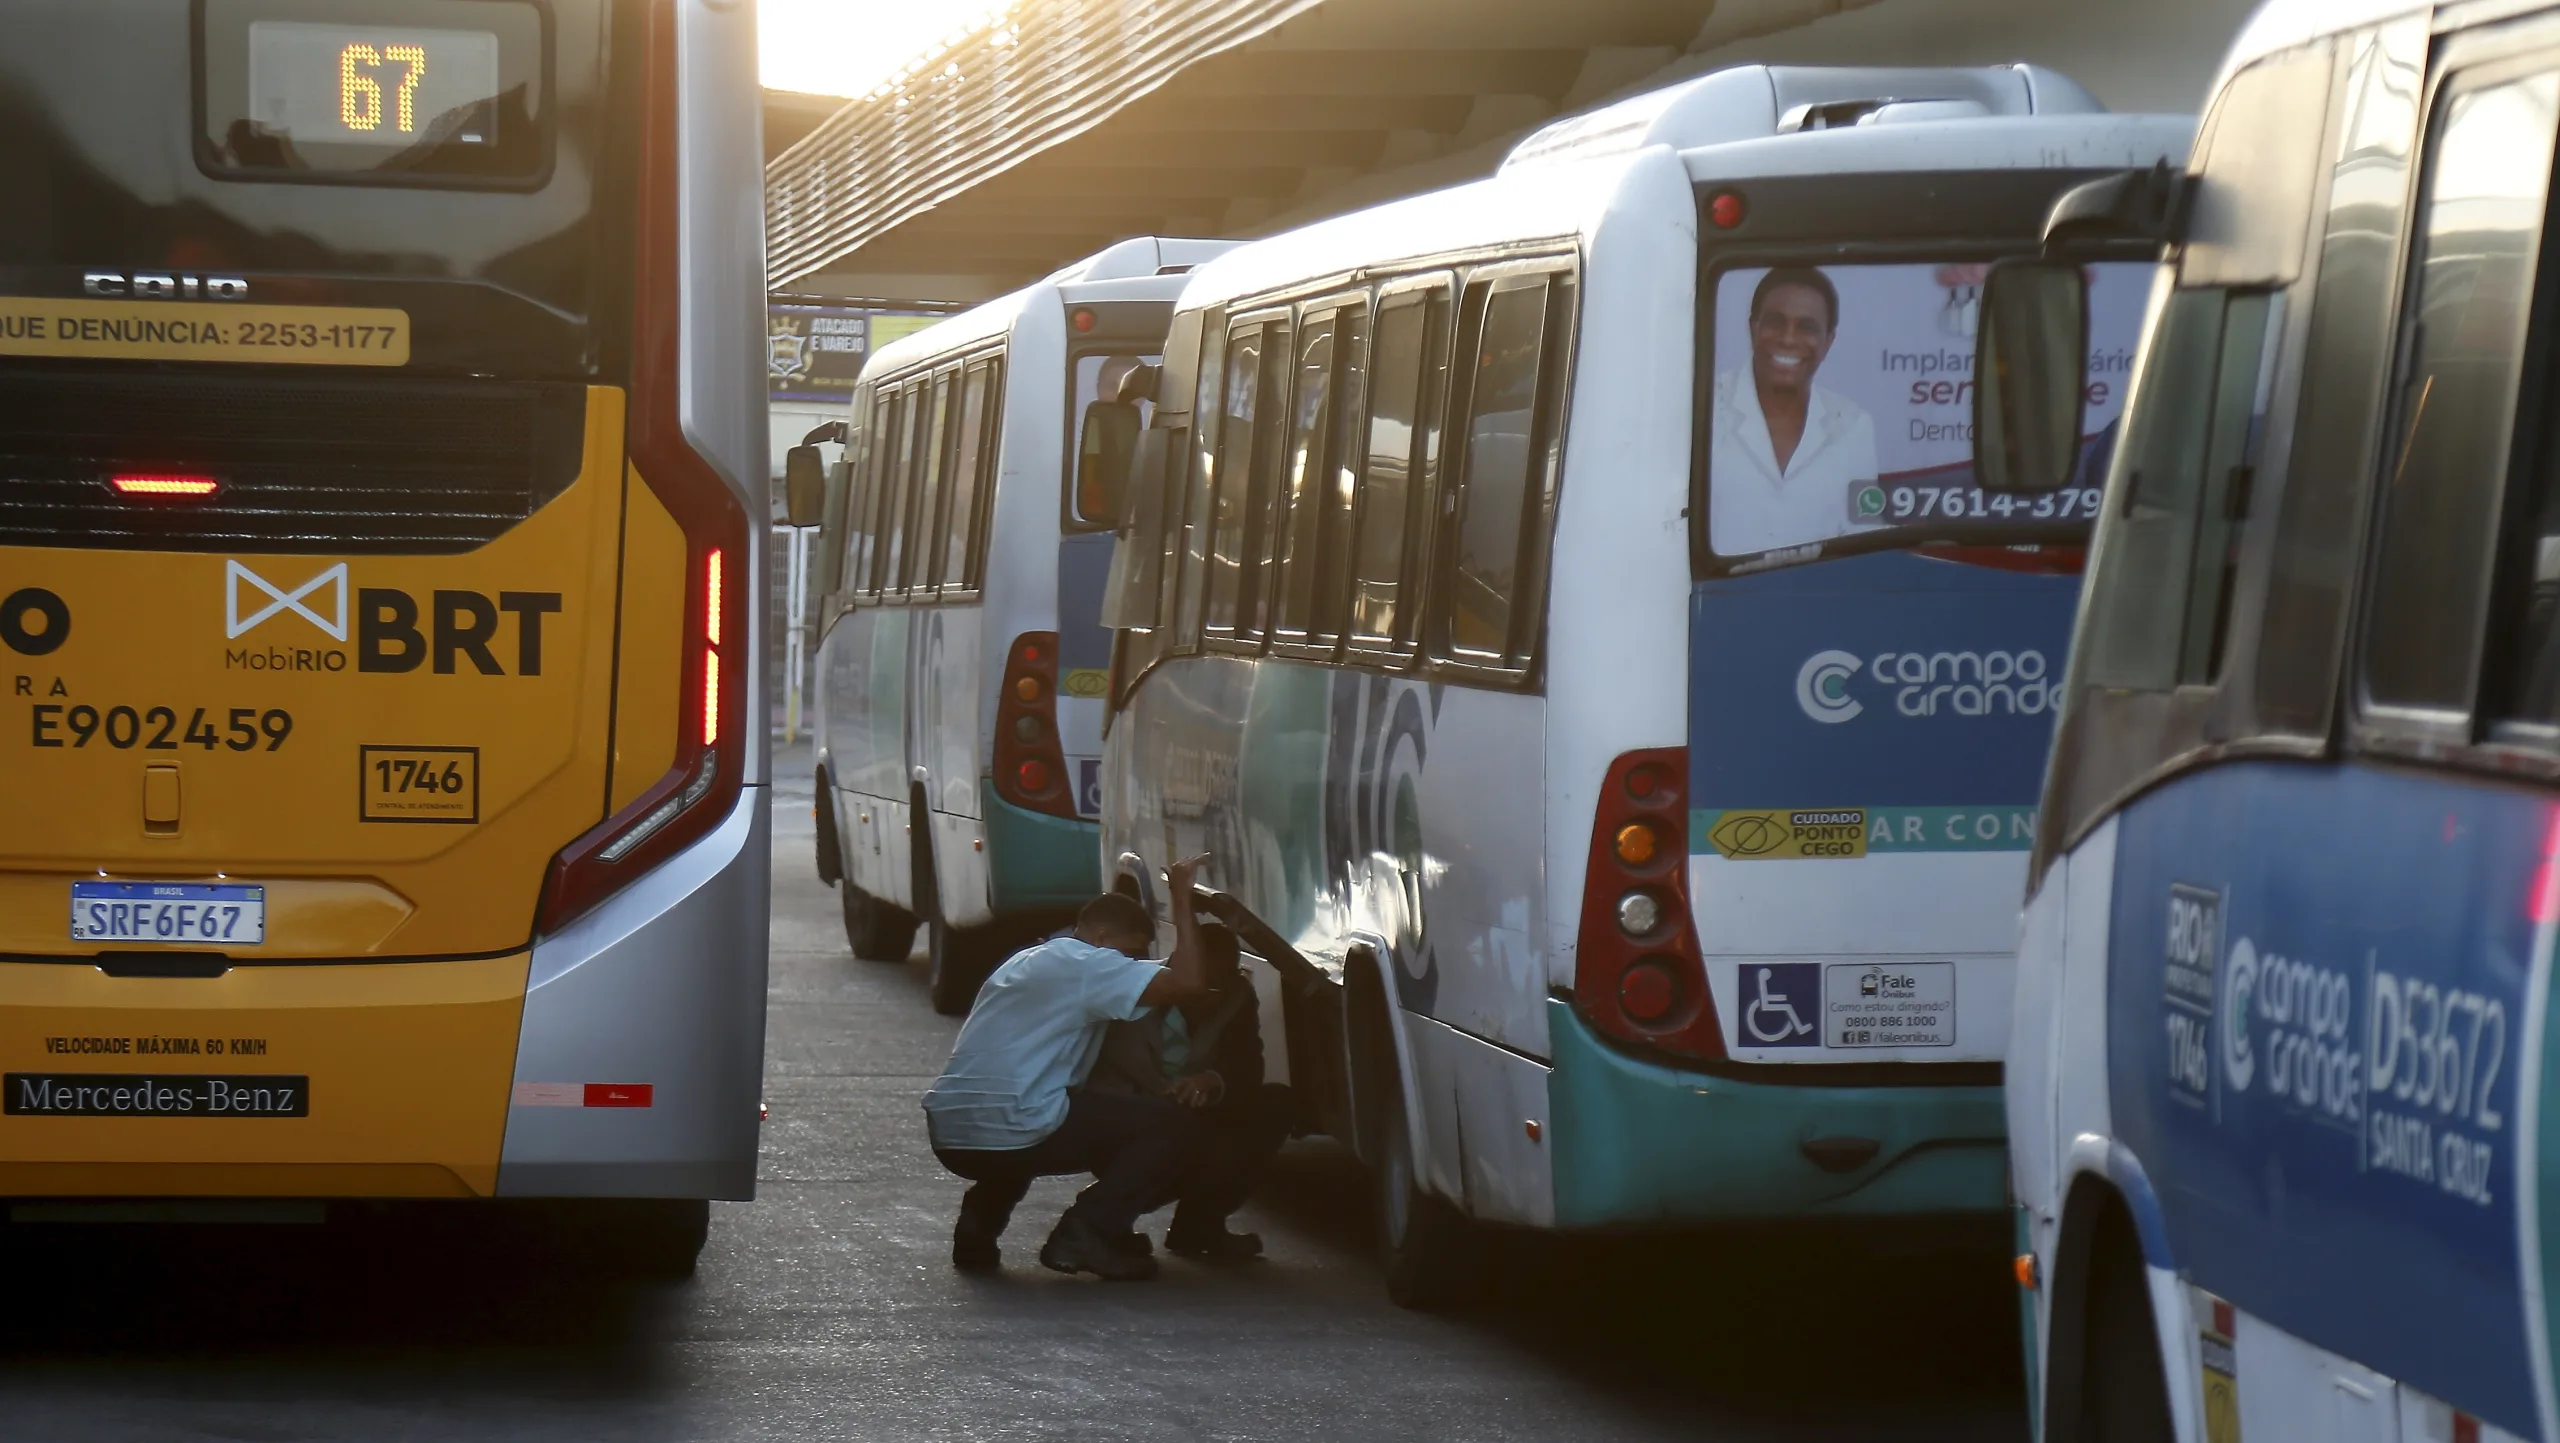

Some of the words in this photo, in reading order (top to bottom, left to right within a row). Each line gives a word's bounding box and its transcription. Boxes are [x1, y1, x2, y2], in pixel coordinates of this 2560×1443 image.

[341, 44, 426, 132] 67
[58, 314, 230, 346] DENÚNCIA:
[238, 321, 397, 350] 2253-1177
[811, 317, 865, 335] ATACADO
[822, 337, 865, 352] VAREJO
[1891, 486, 2101, 519] 97614-379
[225, 646, 347, 673] MobiRIO
[358, 587, 563, 676] BRT
[32, 704, 294, 752] E902459
[376, 760, 464, 794] 1746
[1793, 813, 1861, 825] CUIDADO
[1869, 816, 1925, 843] AR
[1793, 827, 1861, 841] PONTO
[1801, 841, 1854, 856] CEGO
[154, 888, 184, 896] BRASIL
[88, 903, 241, 939] SRF6F67
[1881, 975, 1915, 988] Fale
[1830, 1002, 1861, 1012] Como
[1865, 1002, 1894, 1012] estou
[1898, 1001, 1951, 1013] dirigindo?
[1846, 1017, 1877, 1027] 0800
[1881, 1017, 1903, 1027] 886
[1907, 1016, 1937, 1026] 1000
[46, 1037, 130, 1054] VELOCIDADE
[136, 1035, 200, 1054] MÁXIMA
[206, 1039, 224, 1054] 60
[230, 1039, 267, 1055] KM/H
[2369, 970, 2506, 1132] D53672
[20, 1079, 294, 1112] Mercedes-Benz
[2371, 1109, 2435, 1183] SANTA
[2439, 1131, 2493, 1206] CRUZ
